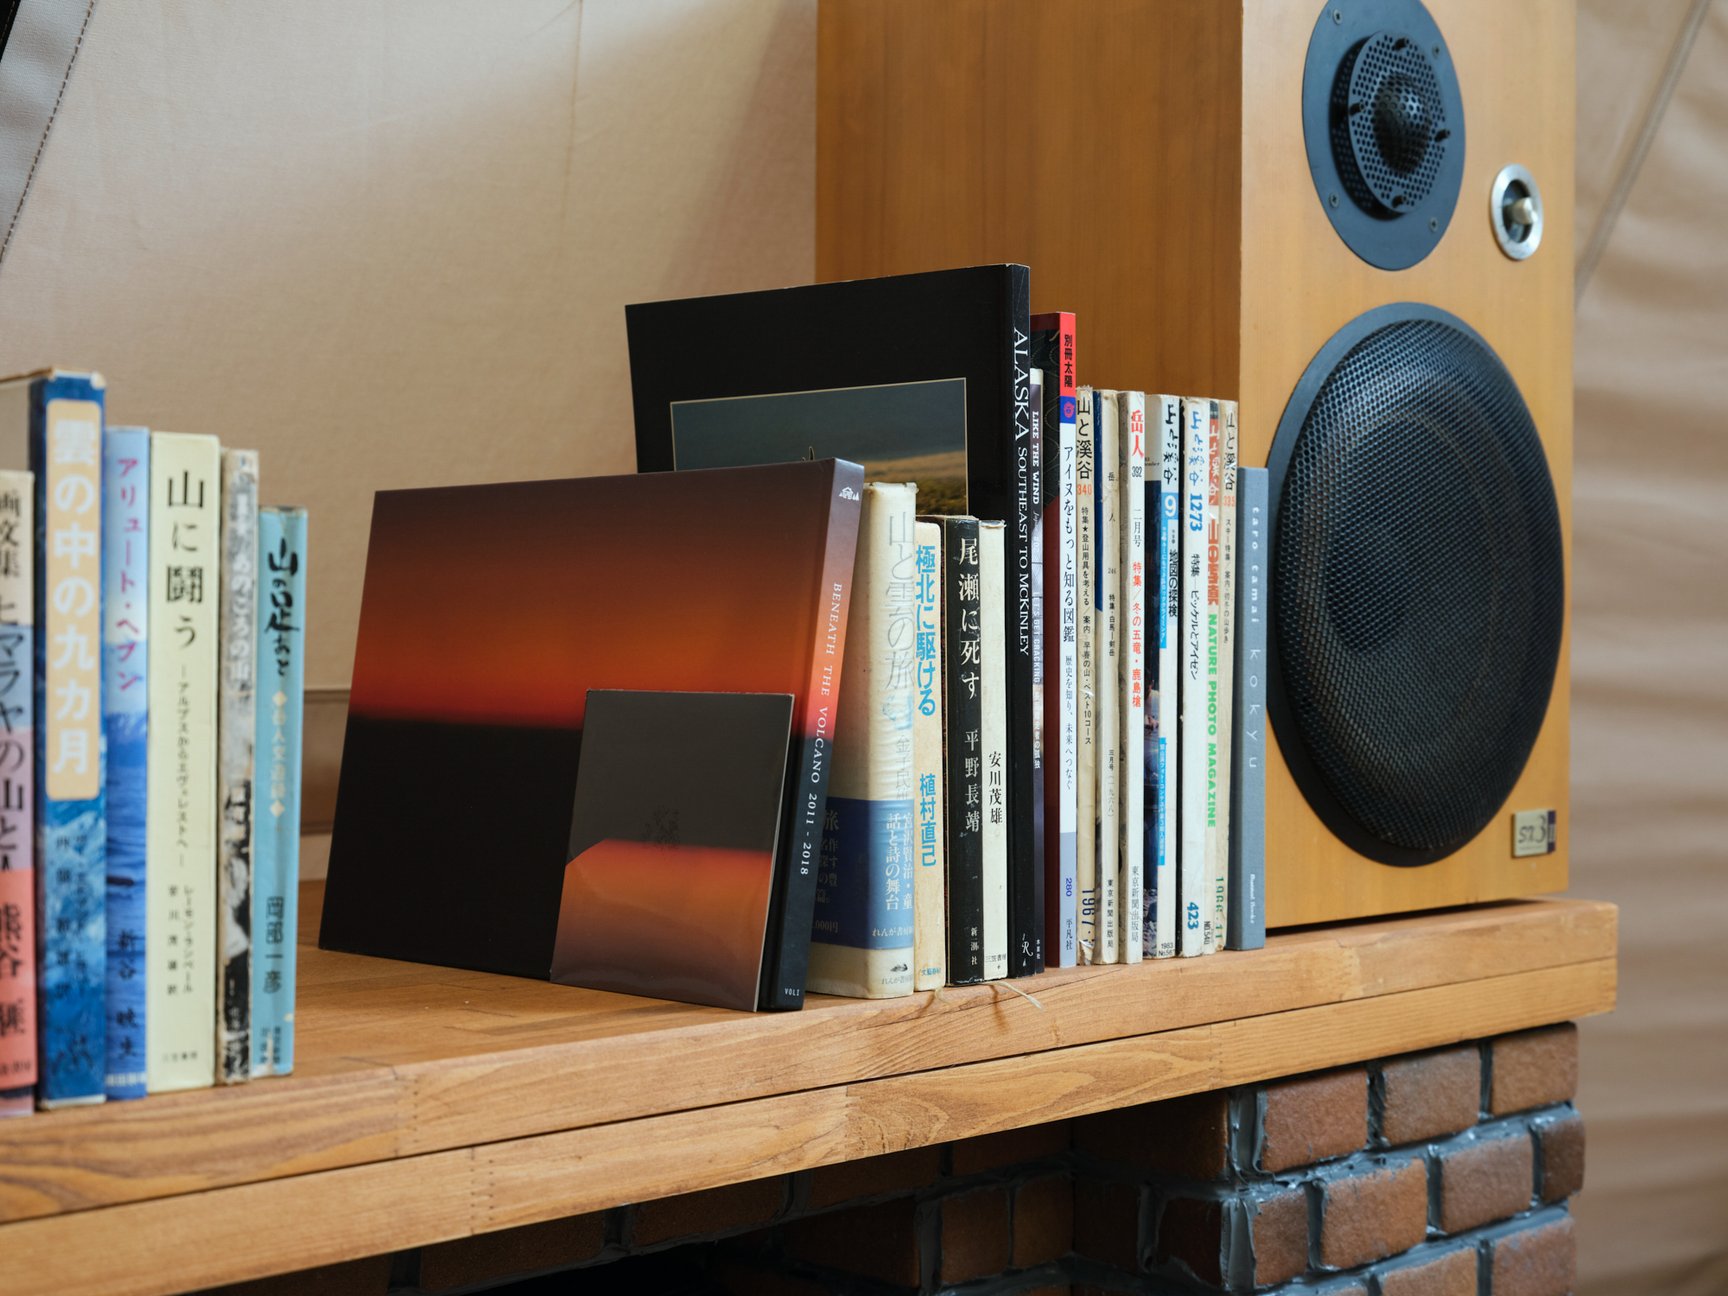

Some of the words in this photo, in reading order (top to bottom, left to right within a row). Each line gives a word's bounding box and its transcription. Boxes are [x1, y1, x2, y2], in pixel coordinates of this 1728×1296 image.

[1014, 327, 1030, 441] ALASKA
[1063, 333, 1074, 389] 別冊太陽
[1032, 442, 1040, 468] THE
[1131, 410, 1145, 459] 岳人
[1017, 446, 1029, 543] SOUTHEAST
[1032, 471, 1040, 505] WIND
[1078, 484, 1093, 496] 340
[1132, 466, 1143, 478] 392
[1165, 495, 1177, 518] 9
[1189, 493, 1203, 532] 1273
[1252, 506, 1260, 550] taro
[166, 470, 204, 650] 山に闘う
[1018, 546, 1029, 569] TO
[1063, 446, 1076, 643] アイヌをもっと知る図鑑
[825, 582, 843, 656] BENEATH
[915, 544, 937, 717] 極北に駆ける
[957, 536, 982, 701] 尾瀬に死す
[1019, 573, 1030, 657] MCKINLEY
[1207, 613, 1218, 676] NATURE
[820, 665, 833, 697] THE
[1207, 680, 1218, 736] PHOTO
[810, 707, 829, 784] VOLCANO
[805, 792, 818, 825] 2011
[964, 729, 981, 833] 平野長靖
[988, 751, 1004, 825] 安川茂雄
[1206, 743, 1218, 828] MAGAZINE
[919, 773, 937, 868] 植村直己
[799, 842, 812, 876] 2018
[1064, 877, 1073, 897] 280
[1187, 901, 1200, 931] 423
